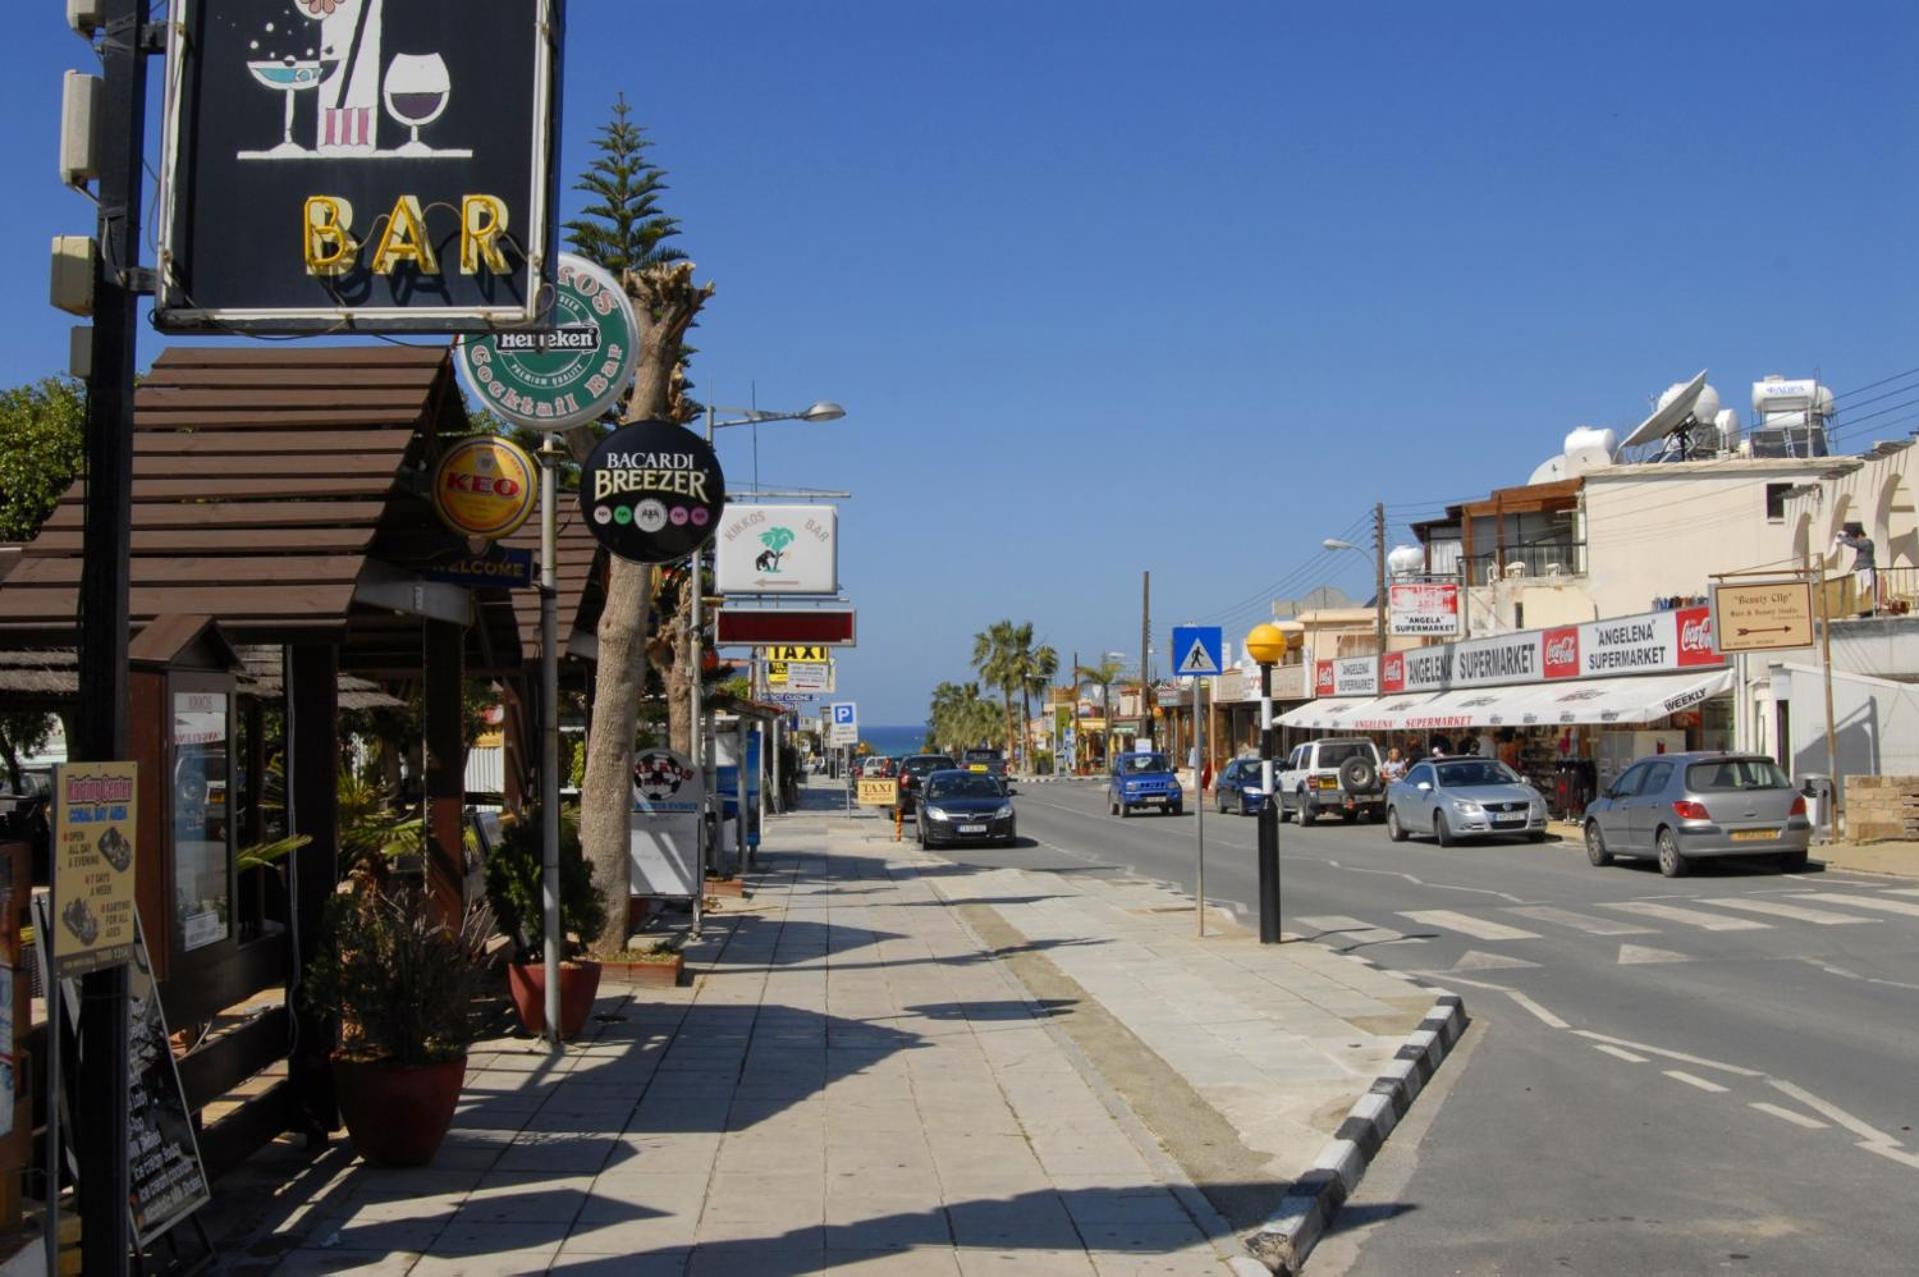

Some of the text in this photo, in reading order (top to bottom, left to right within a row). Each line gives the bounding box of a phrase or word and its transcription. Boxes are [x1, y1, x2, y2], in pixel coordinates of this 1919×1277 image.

[303, 194, 512, 277] BAR
[471, 344, 623, 417] Cocktail Bar
[606, 451, 695, 469] BACARDI
[445, 471, 521, 498] KEO
[594, 468, 710, 503] BREEZER
[725, 511, 830, 543] KIKKOS BAR
[1395, 624, 1455, 633] SUPERMARKET
[774, 646, 825, 660] TAXI
[1459, 643, 1536, 680] SUPERMARKET
[1589, 646, 1666, 670] SUPERMARKET
[1664, 687, 1706, 712] WEEKLY
[837, 707, 850, 722] P
[1404, 715, 1473, 728] SUPERMARKET
[863, 784, 893, 793] TAXI
